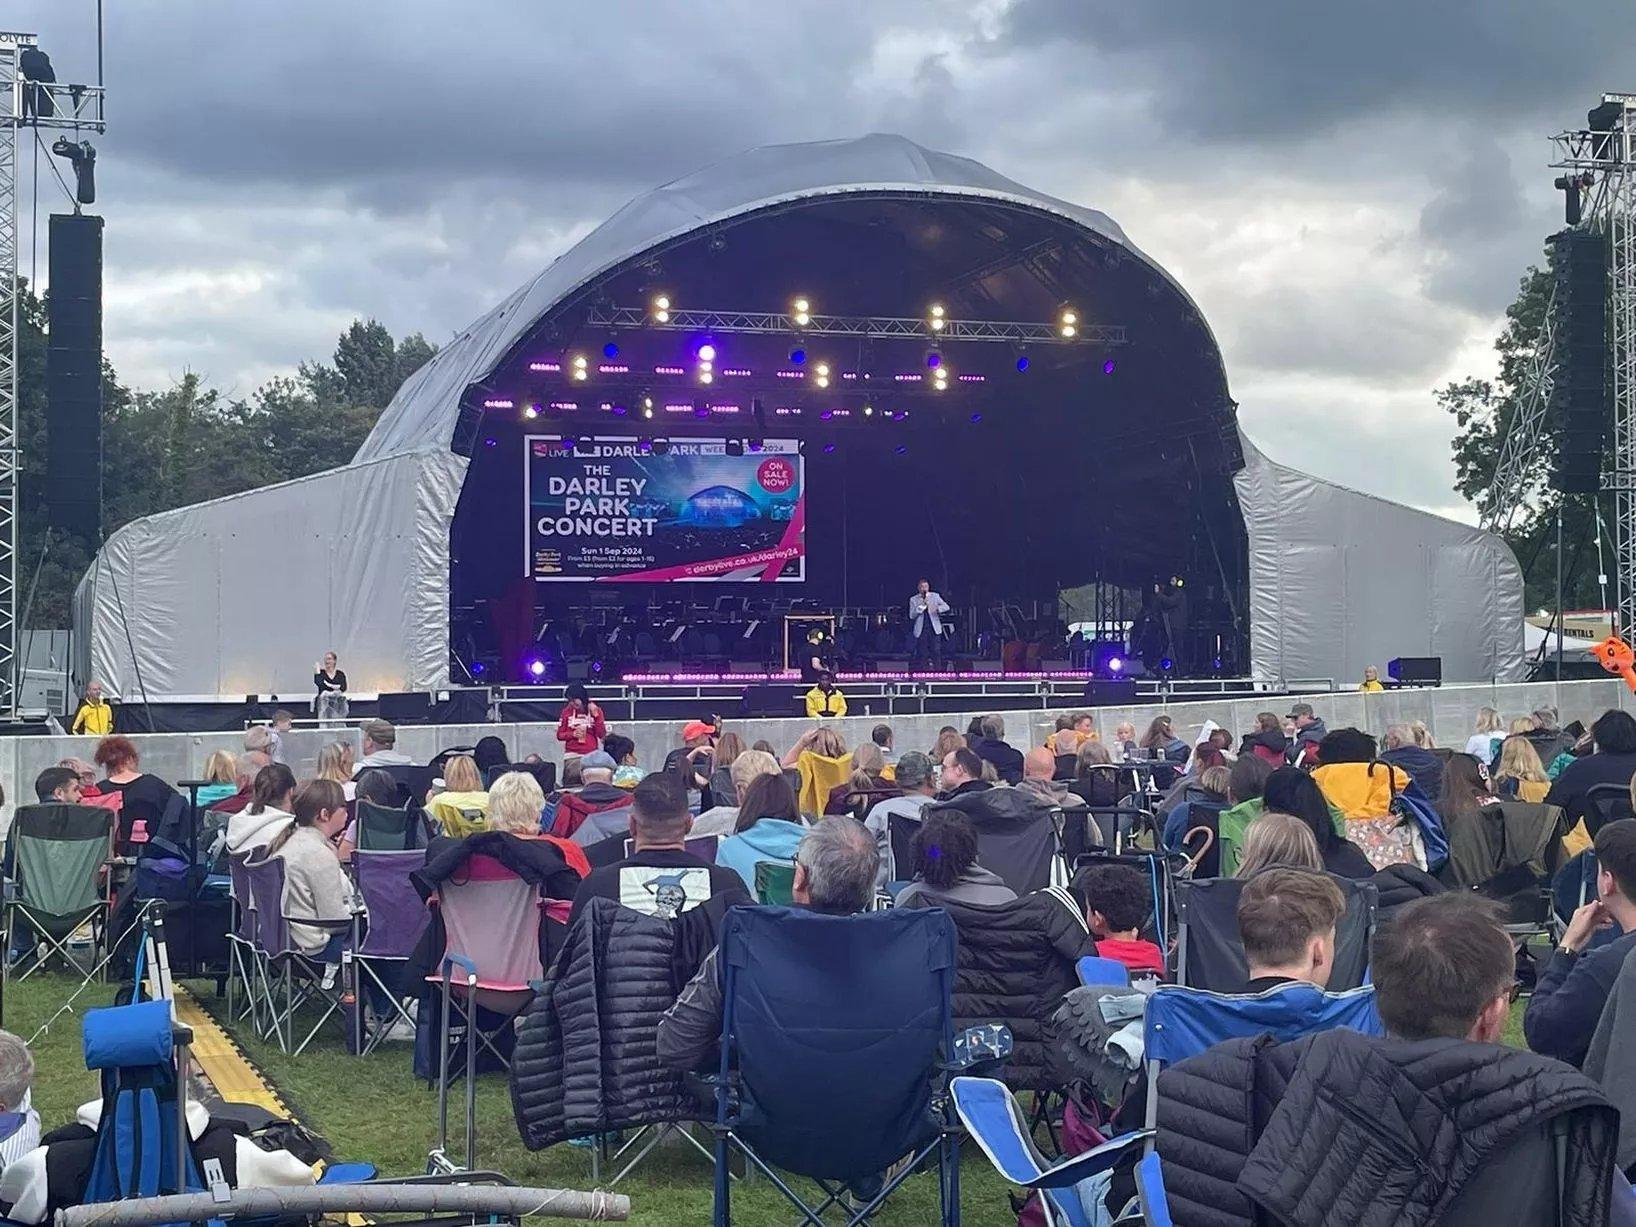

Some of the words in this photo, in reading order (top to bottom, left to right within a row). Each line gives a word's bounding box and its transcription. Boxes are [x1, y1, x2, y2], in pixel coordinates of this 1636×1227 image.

[549, 449, 570, 458] LIVE
[668, 445, 698, 456] ARK
[583, 465, 612, 476] THE
[769, 462, 783, 470] ON
[764, 470, 788, 479] SALE
[549, 477, 647, 496] DARLEY
[763, 479, 790, 487] NOW!
[565, 497, 630, 516] PARK
[537, 517, 658, 536] CONCERT
[581, 547, 598, 555] Sun
[599, 547, 603, 555] 1
[604, 547, 621, 556] Sep
[622, 547, 643, 555] 2024
[1563, 628, 1594, 639] RENTALS
